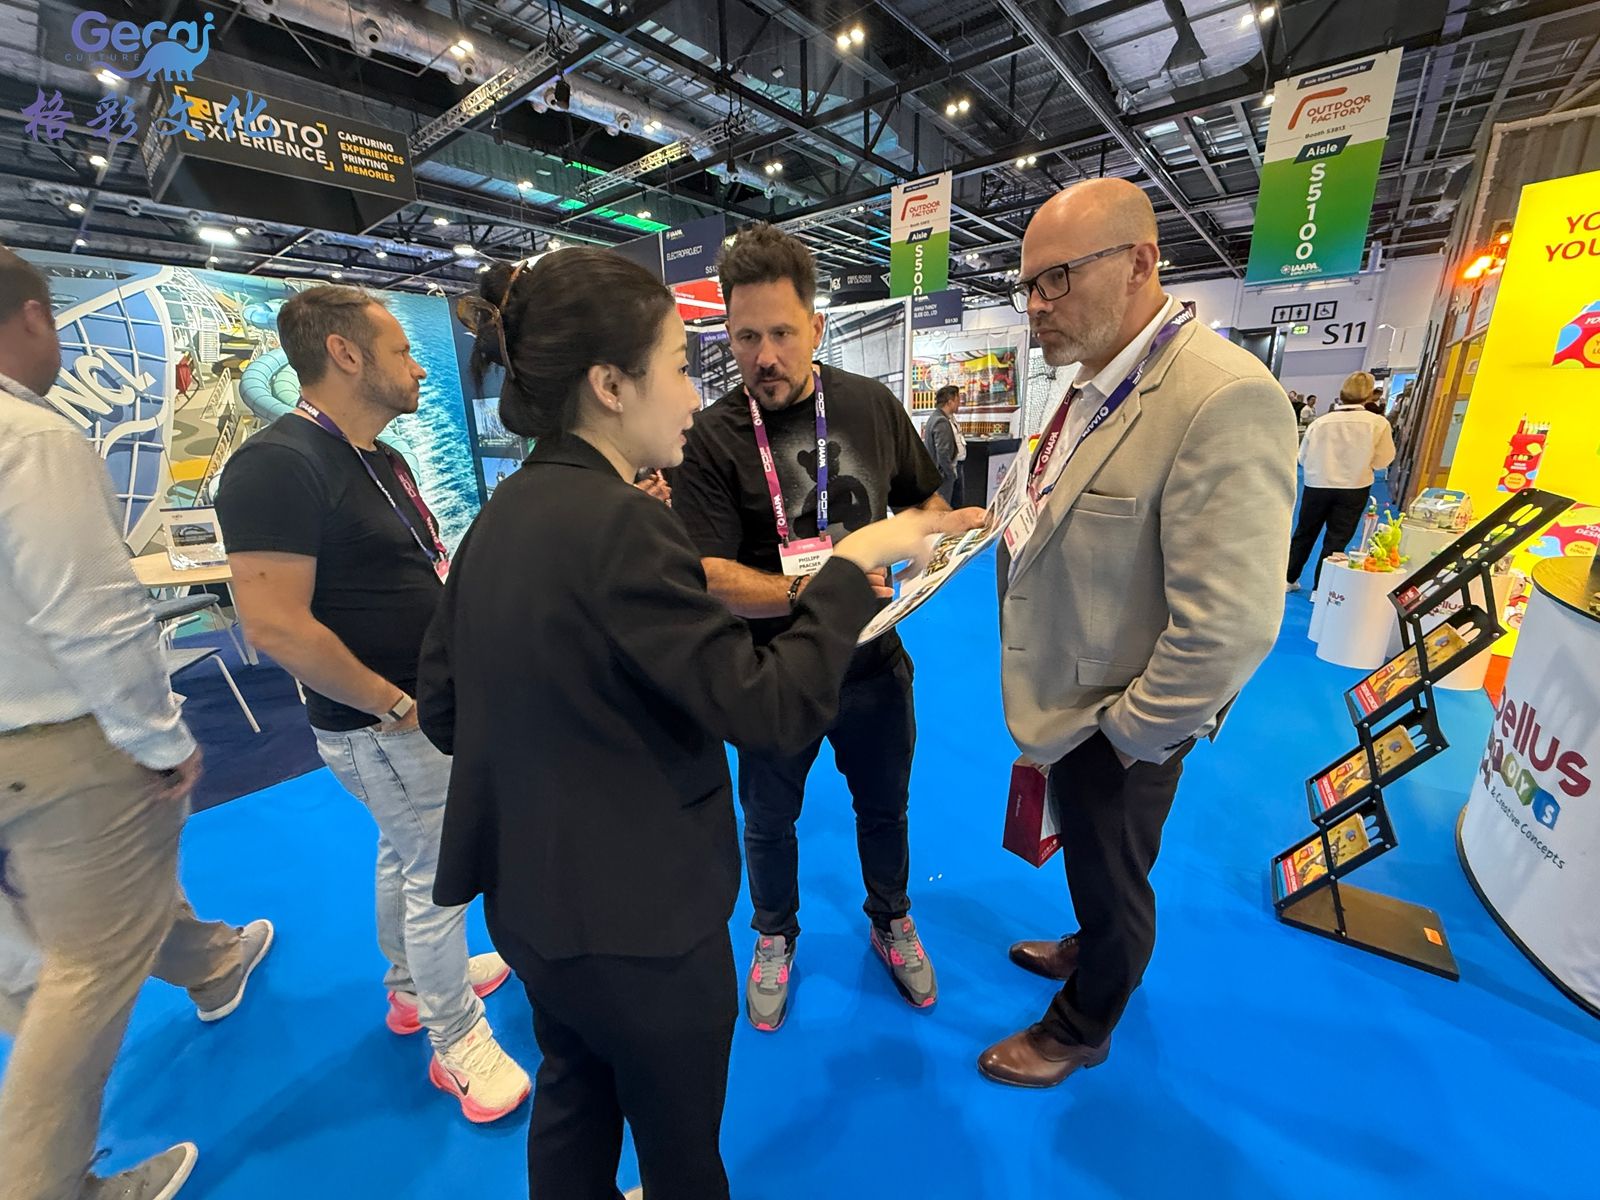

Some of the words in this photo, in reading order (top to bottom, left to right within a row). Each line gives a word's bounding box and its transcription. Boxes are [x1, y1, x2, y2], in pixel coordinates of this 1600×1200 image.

[1307, 94, 1371, 117] OUTDOOR
[1311, 105, 1365, 124] FACTORY
[189, 118, 328, 165] EXPERIENCE
[337, 131, 395, 153] CAPTURING
[1305, 143, 1338, 158] Aisle
[339, 142, 405, 165] EXPERIENCES
[341, 153, 389, 171] PRINTING
[343, 164, 396, 183] MEMORIES
[909, 200, 941, 214] OUTDOOR
[911, 208, 938, 218] FACTORY
[1296, 163, 1325, 260] S5100
[911, 231, 928, 241] Aisle
[1322, 321, 1367, 345] S11
[45, 348, 156, 430] NCL
[1495, 792, 1520, 829] Creative
[1520, 823, 1566, 870] Concepts
